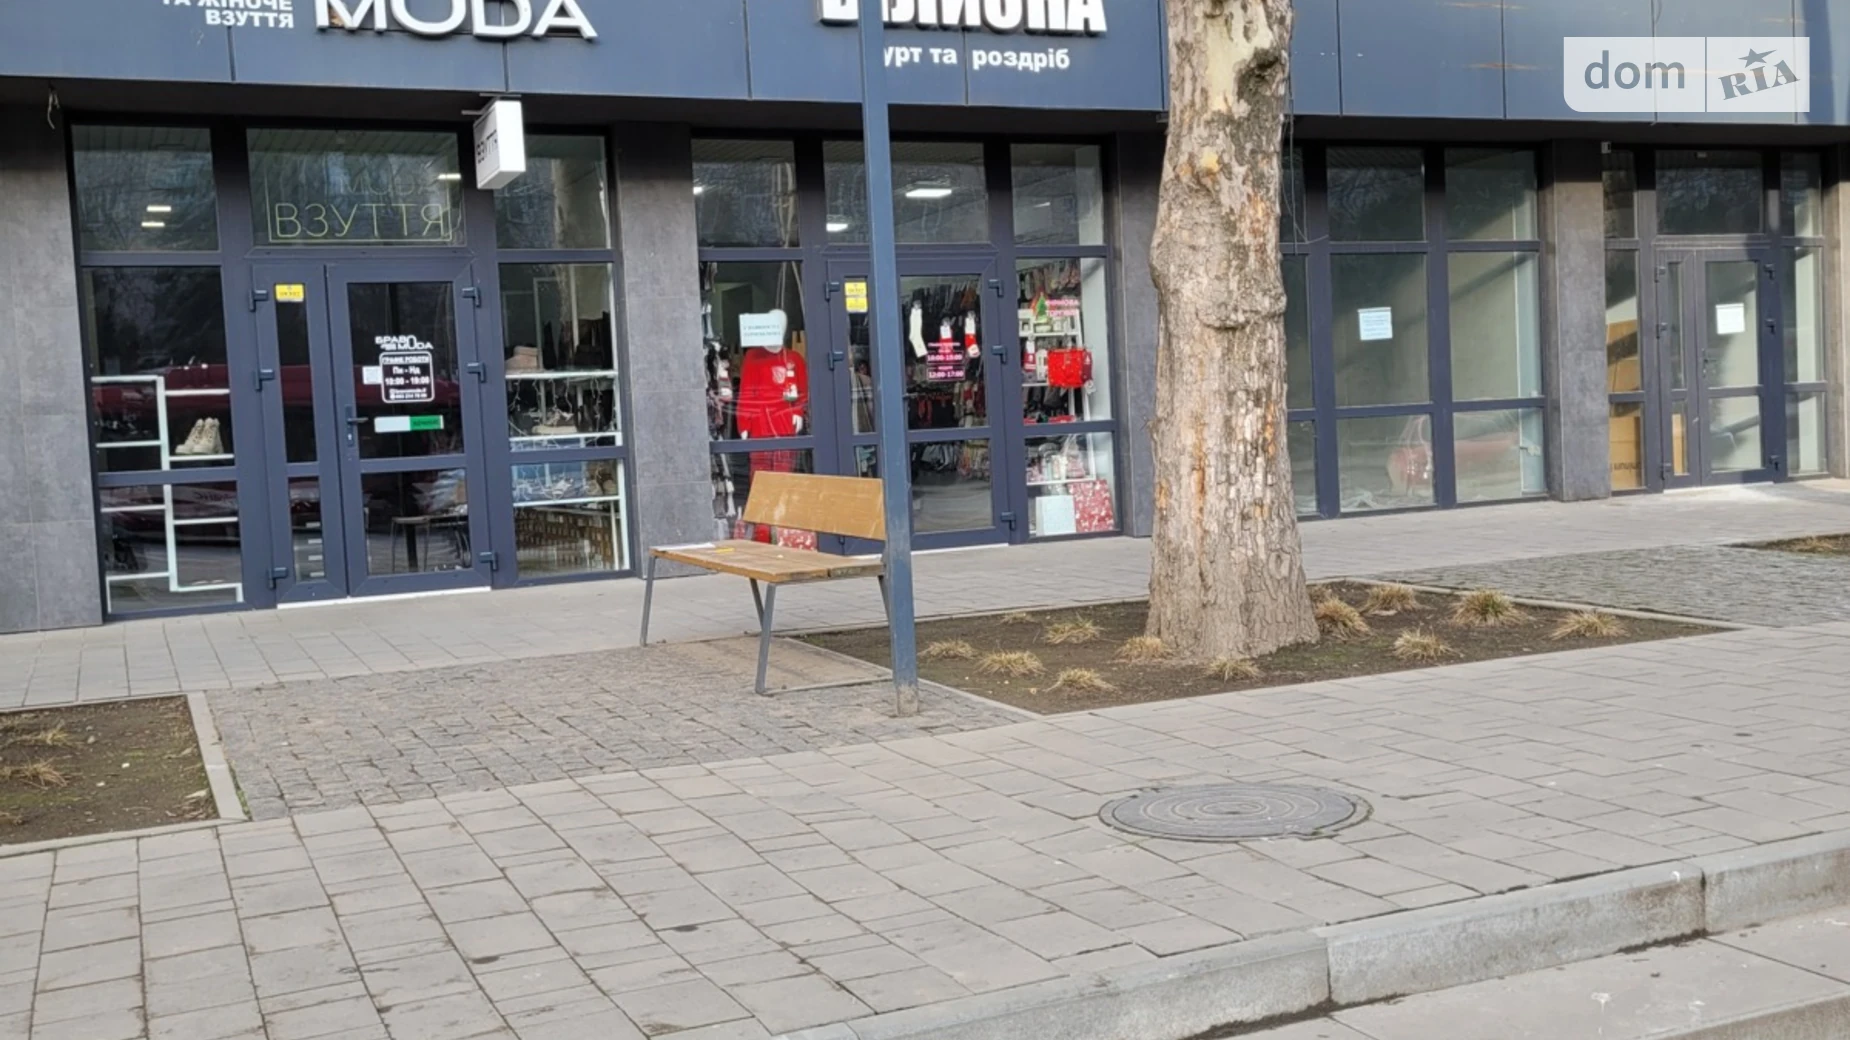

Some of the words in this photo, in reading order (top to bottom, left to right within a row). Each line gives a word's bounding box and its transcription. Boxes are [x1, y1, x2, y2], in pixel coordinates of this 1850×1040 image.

[205, 9, 294, 29] ВЗУТТЯ
[883, 46, 922, 67] урт
[929, 47, 958, 65] та
[972, 48, 1071, 72] роздріб
[275, 203, 445, 238] ВЗУТТЯ
